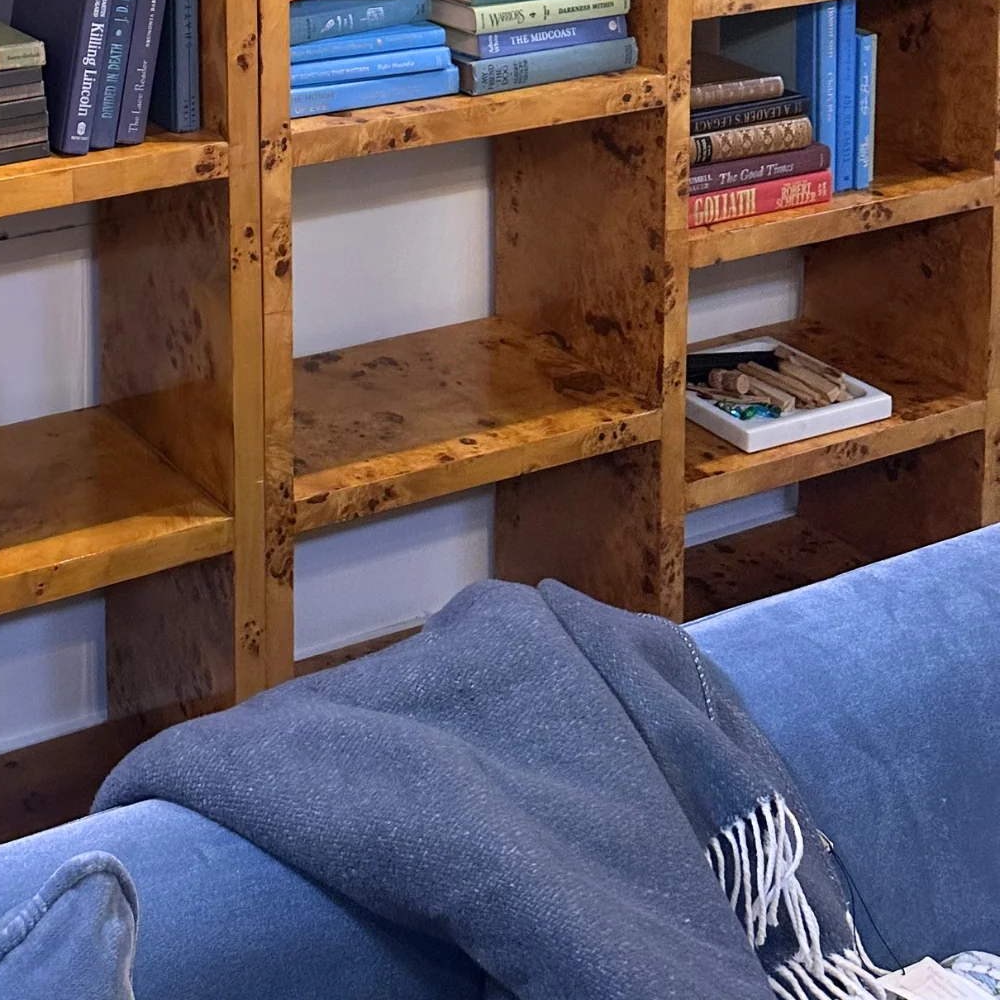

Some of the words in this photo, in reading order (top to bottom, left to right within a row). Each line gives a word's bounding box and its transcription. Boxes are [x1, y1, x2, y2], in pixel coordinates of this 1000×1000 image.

[489, 8, 526, 28] WARRIORS
[558, 3, 591, 15] DARKNESS
[592, 1, 615, 10] WITHIN
[83, 22, 105, 66] Killing
[510, 35, 530, 46] THE
[531, 27, 577, 43] MIDCOAST
[108, 42, 123, 71] DEATH
[106, 72, 119, 83] IN
[134, 59, 149, 92] Reader
[481, 71, 488, 84] MY
[77, 68, 97, 118] Lincoln
[101, 84, 118, 119] DIVIDED
[131, 93, 144, 114] Lace
[128, 115, 141, 134] The
[692, 115, 733, 133] LEGACY
[734, 105, 783, 125] LEADER'S
[718, 171, 739, 185] The
[739, 166, 766, 180] Good
[766, 161, 795, 176] Times
[694, 188, 757, 226] GOLIATH
[781, 183, 812, 196] ROBERT
